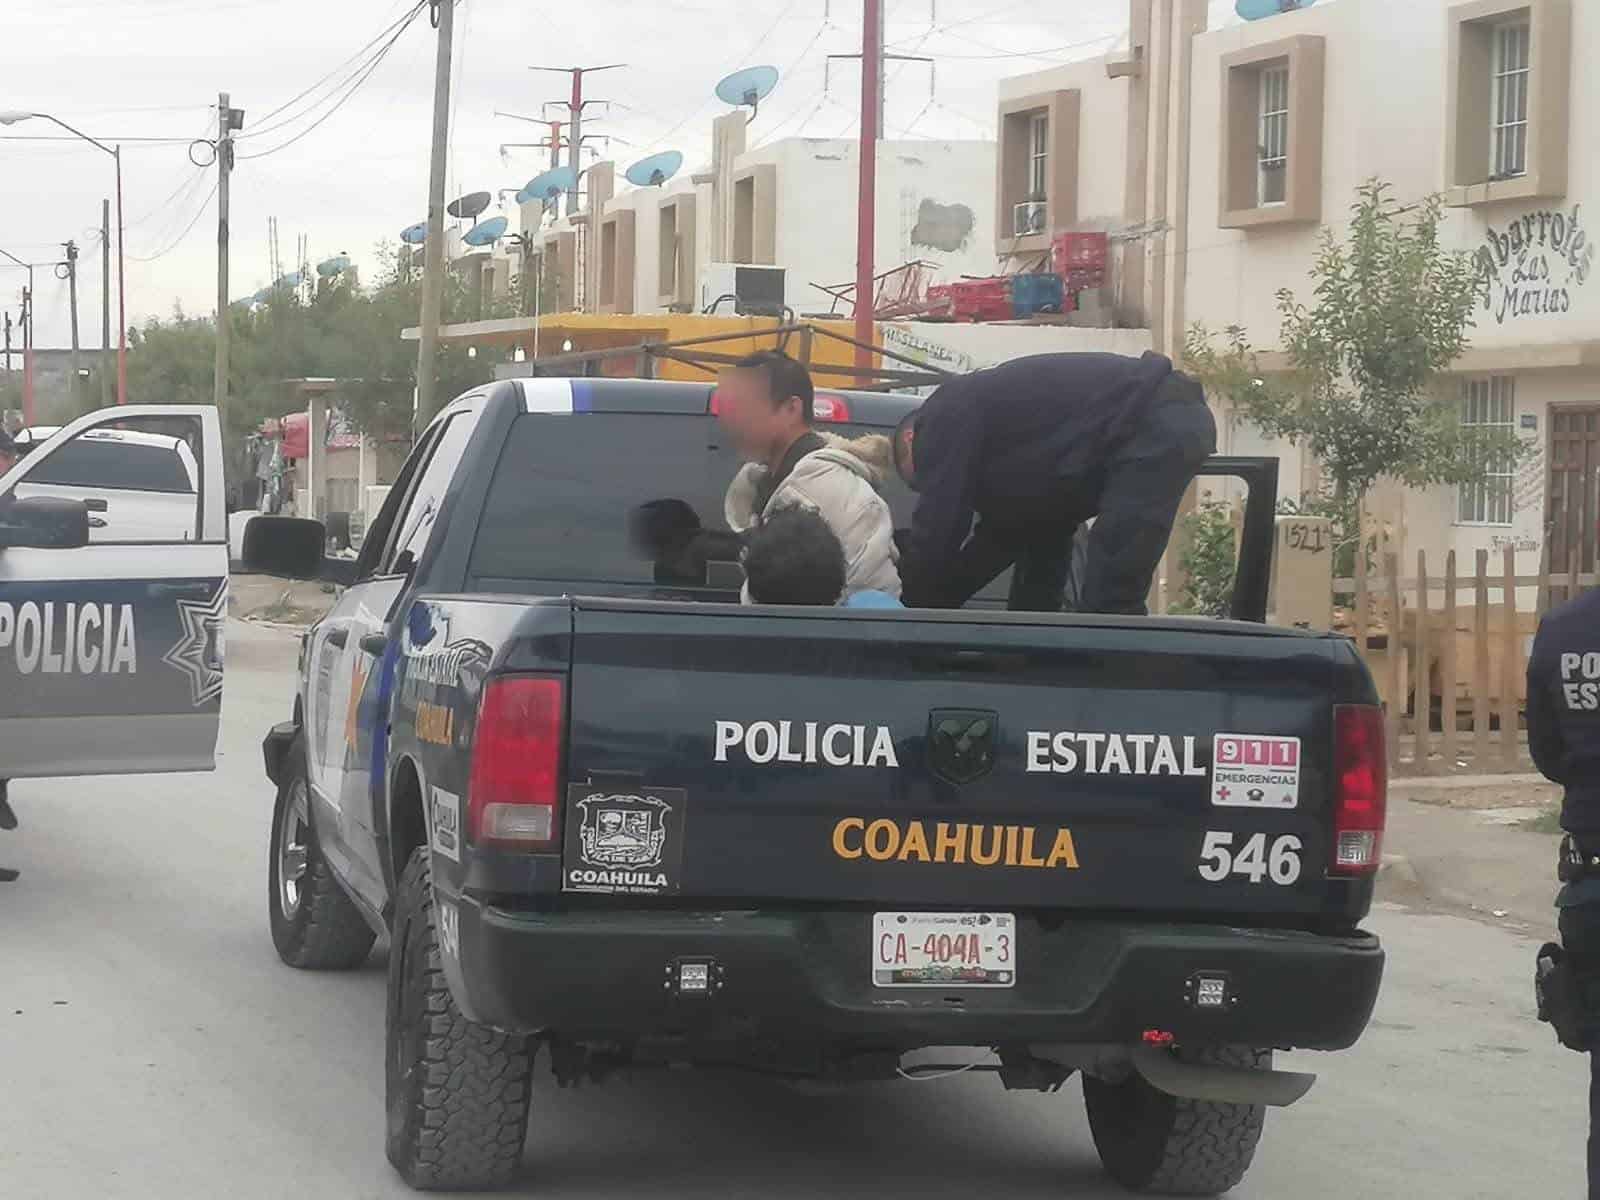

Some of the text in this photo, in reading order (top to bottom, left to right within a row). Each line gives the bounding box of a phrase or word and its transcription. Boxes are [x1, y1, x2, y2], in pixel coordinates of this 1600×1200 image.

[1511, 249, 1549, 284] Las
[1496, 285, 1570, 324] Marias
[0, 600, 137, 674] POLICIA
[713, 720, 1207, 777] POLICIA ESTATAL
[1221, 740, 1290, 764] 911
[1215, 772, 1297, 786] EMERGENCIAS
[832, 817, 1080, 869] COAHUILA
[1198, 830, 1302, 886] 546
[569, 868, 668, 888] COAHUILA
[879, 932, 1010, 964] CA-404A-3
